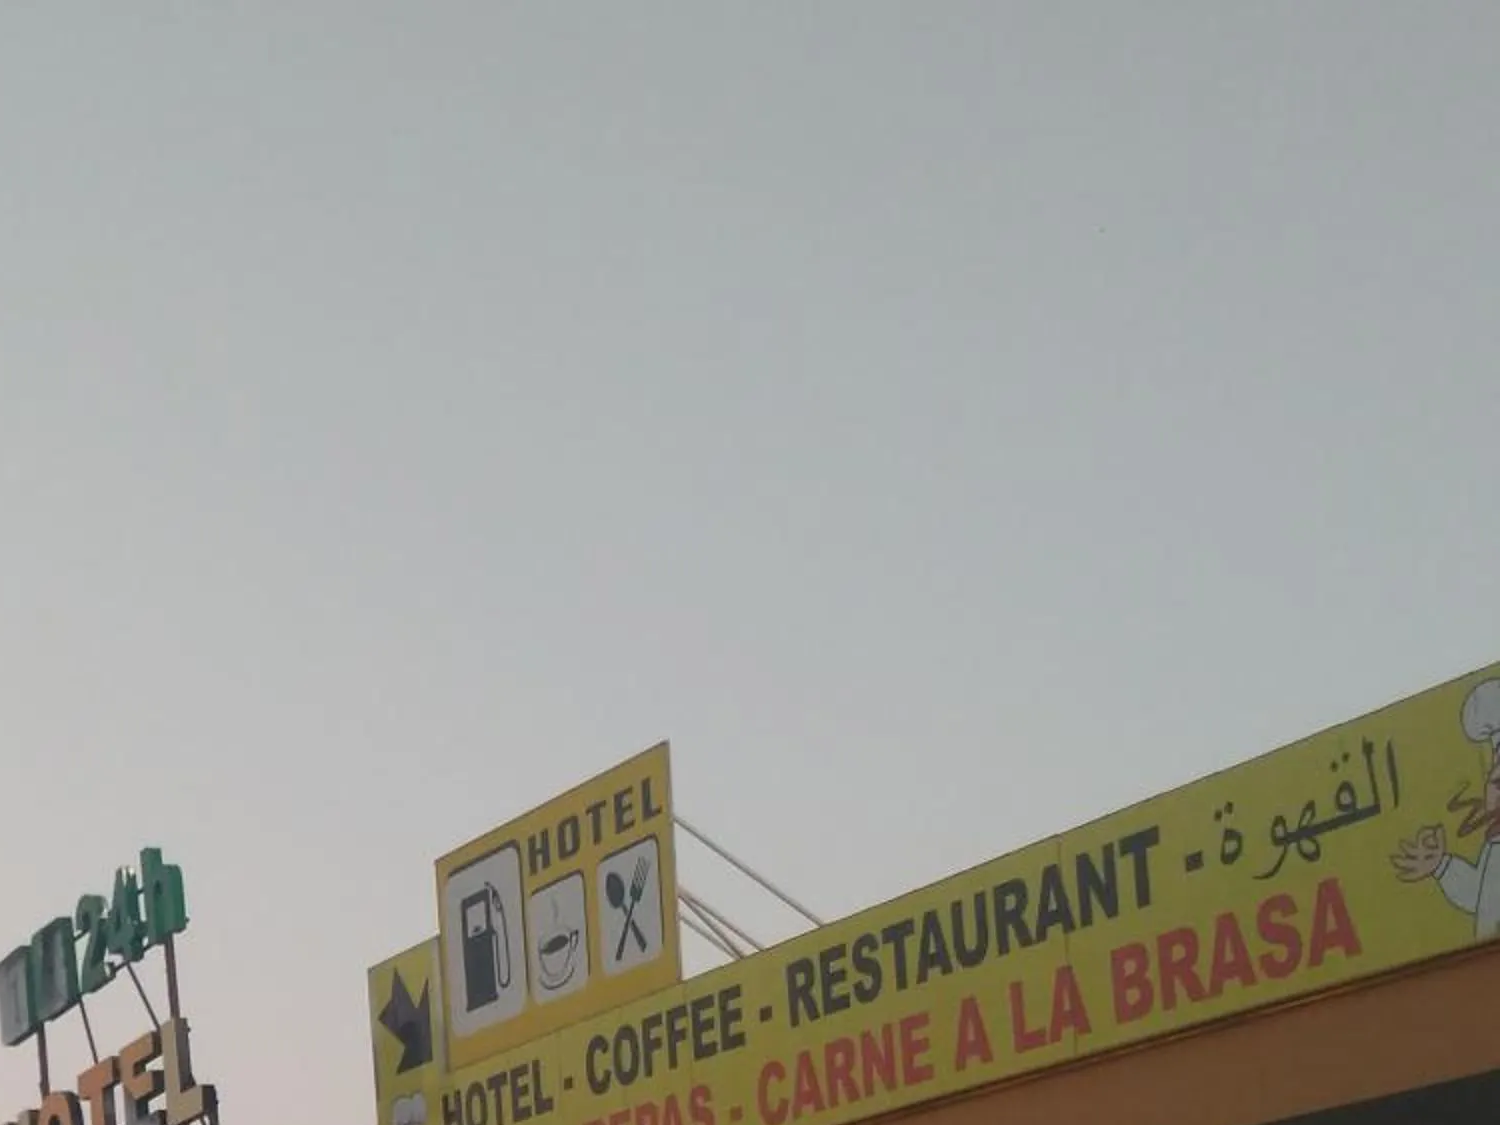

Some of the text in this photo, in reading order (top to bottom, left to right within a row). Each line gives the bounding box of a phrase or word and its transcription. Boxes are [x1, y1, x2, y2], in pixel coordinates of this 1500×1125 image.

[527, 778, 663, 876] HOTEL
[1213, 736, 1399, 881] القهوة
[585, 984, 746, 1097] COFFEE
[786, 825, 1160, 1028] RESTAURANT
[954, 996, 994, 1072] A
[1009, 965, 1093, 1055] LA
[1110, 877, 1363, 1025] BRASA
